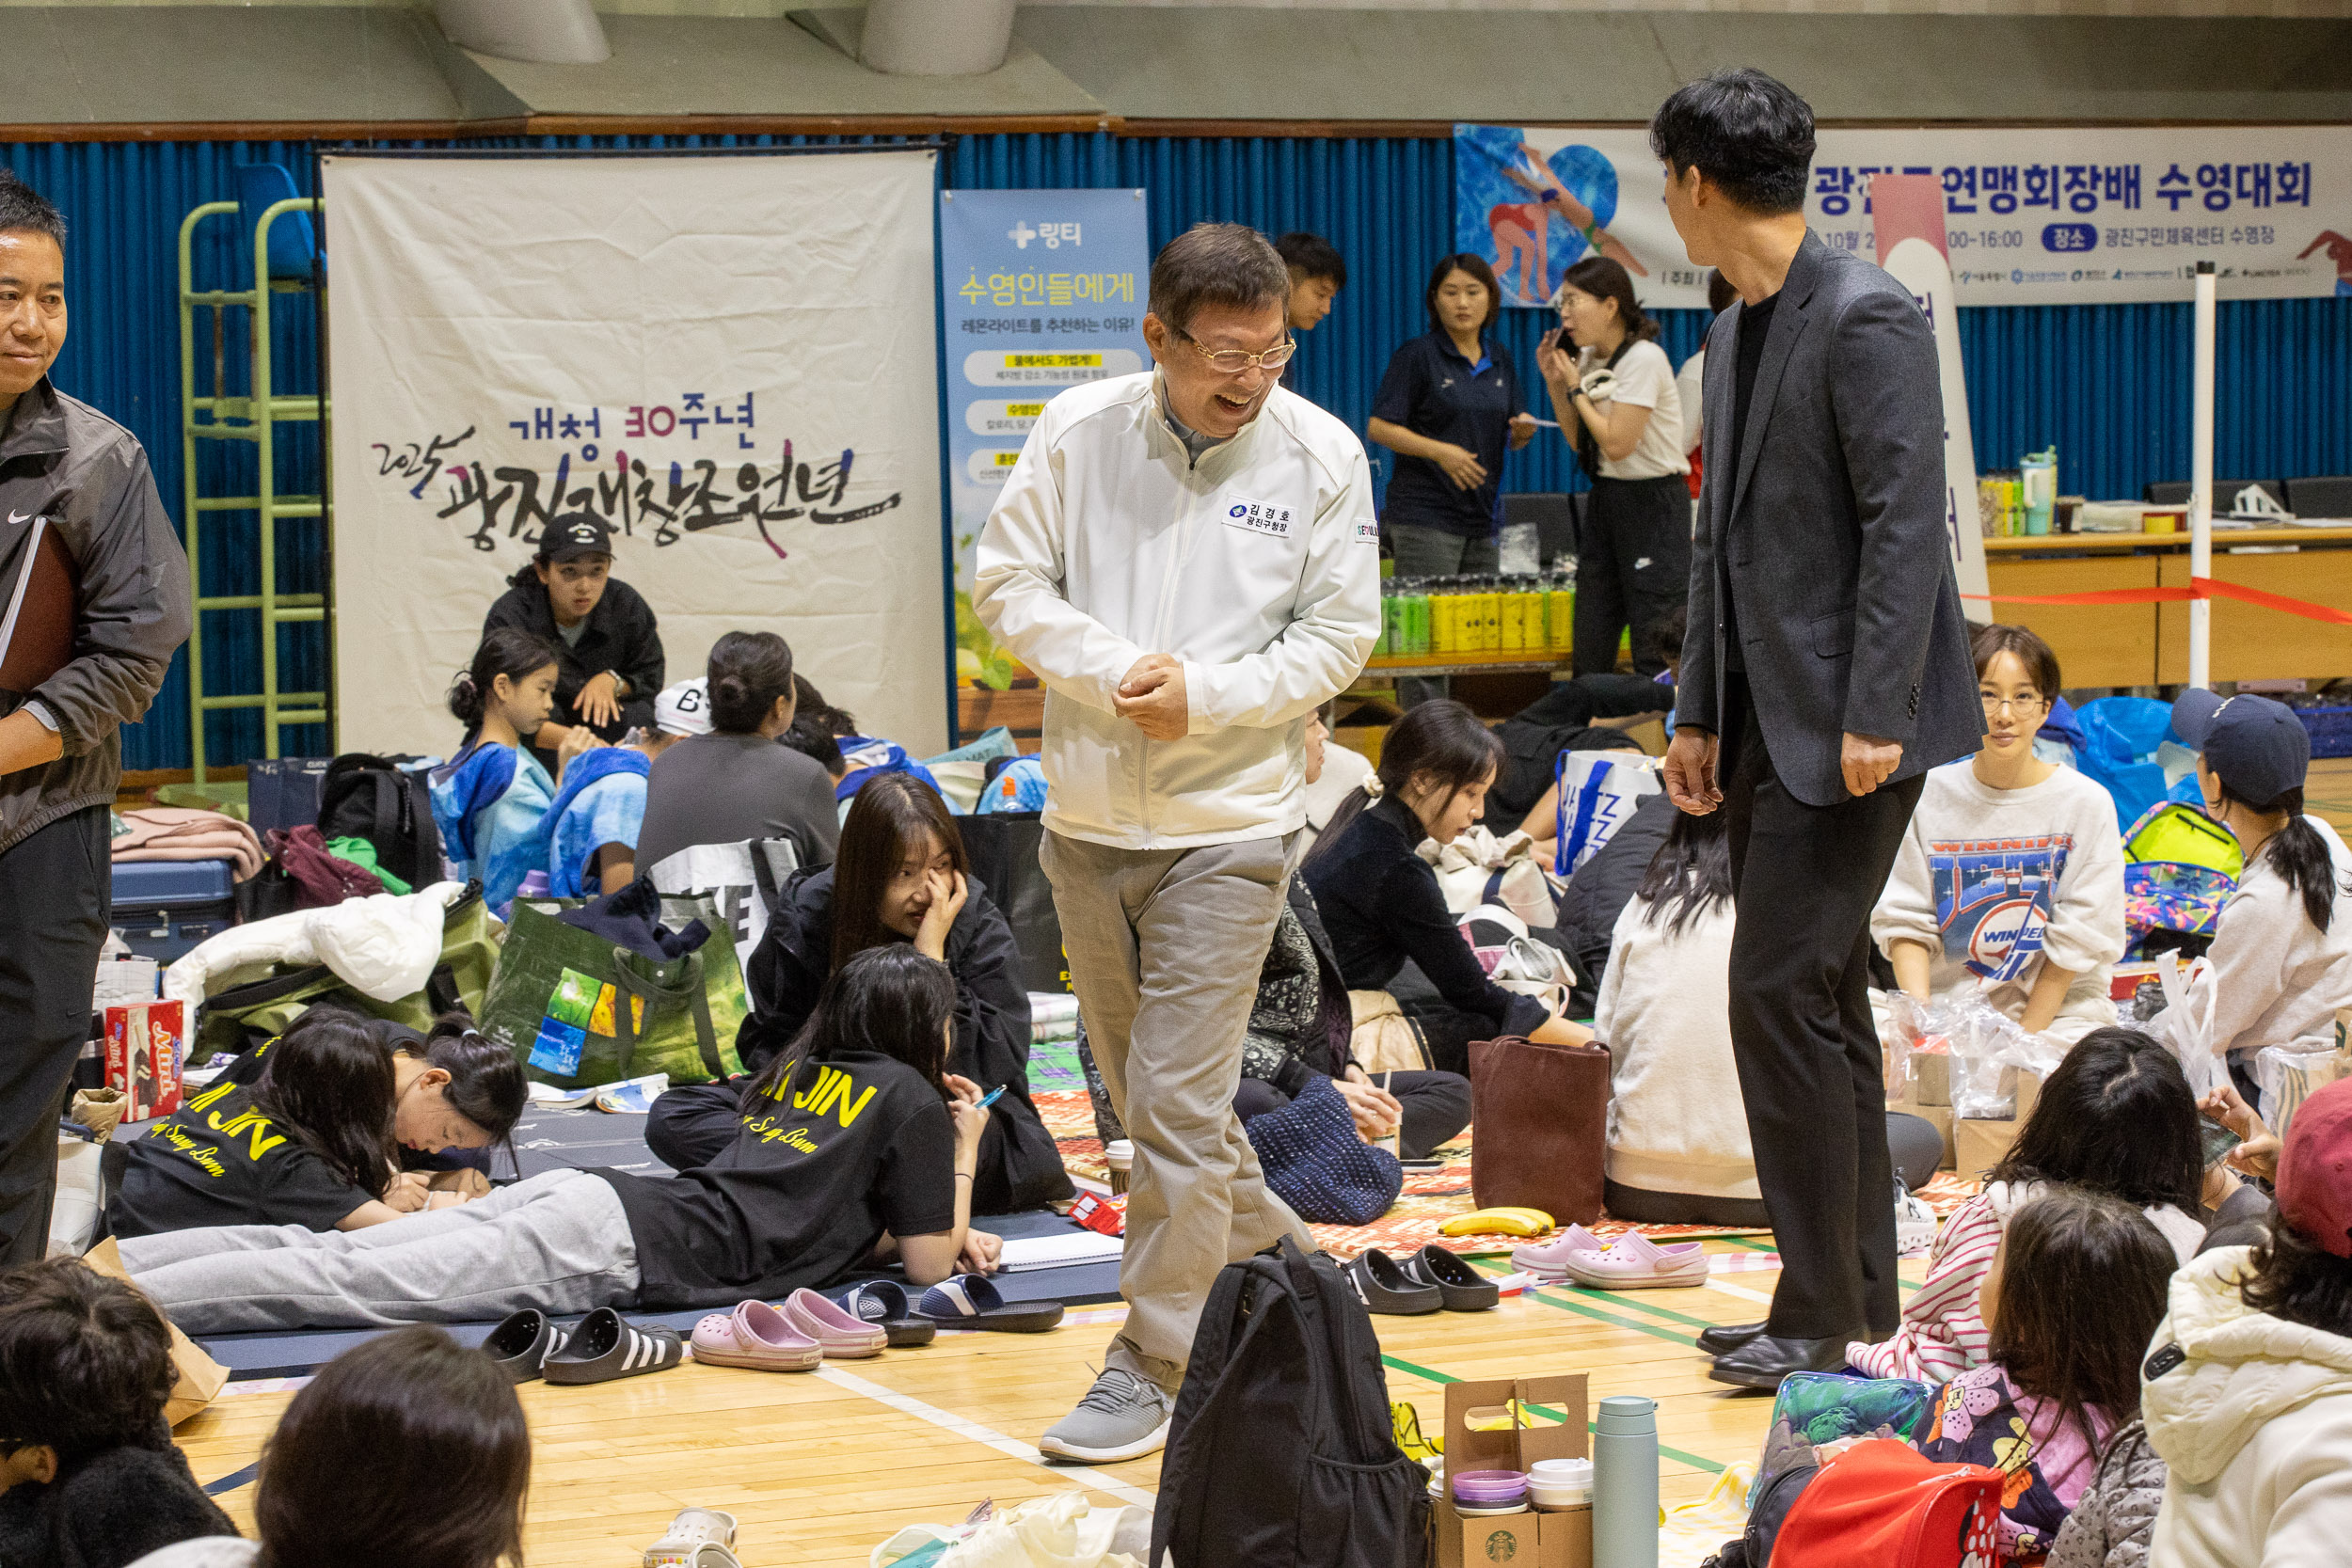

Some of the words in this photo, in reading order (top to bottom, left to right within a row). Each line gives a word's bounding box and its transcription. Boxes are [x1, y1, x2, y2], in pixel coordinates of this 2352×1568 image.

[1814, 163, 2141, 216] 광연맹회장배
[2156, 162, 2311, 212] 수영대회
[1039, 222, 1082, 249] 링티
[2054, 228, 2086, 249] 장소
[2106, 224, 2224, 247] 광진구민체육센터
[2231, 225, 2275, 246] 수영장
[959, 269, 1135, 307] 수영인들에게
[961, 318, 1041, 334] 레몬라이트를
[1046, 318, 1100, 334] 추천하는
[1103, 317, 1136, 333] 이유!
[509, 407, 601, 462] 개청
[625, 391, 755, 450] 30주년
[372, 425, 476, 499] 2025
[1247, 516, 1288, 533] 광진구청장
[793, 1065, 878, 1128] JIN
[207, 1105, 287, 1162] JIN
